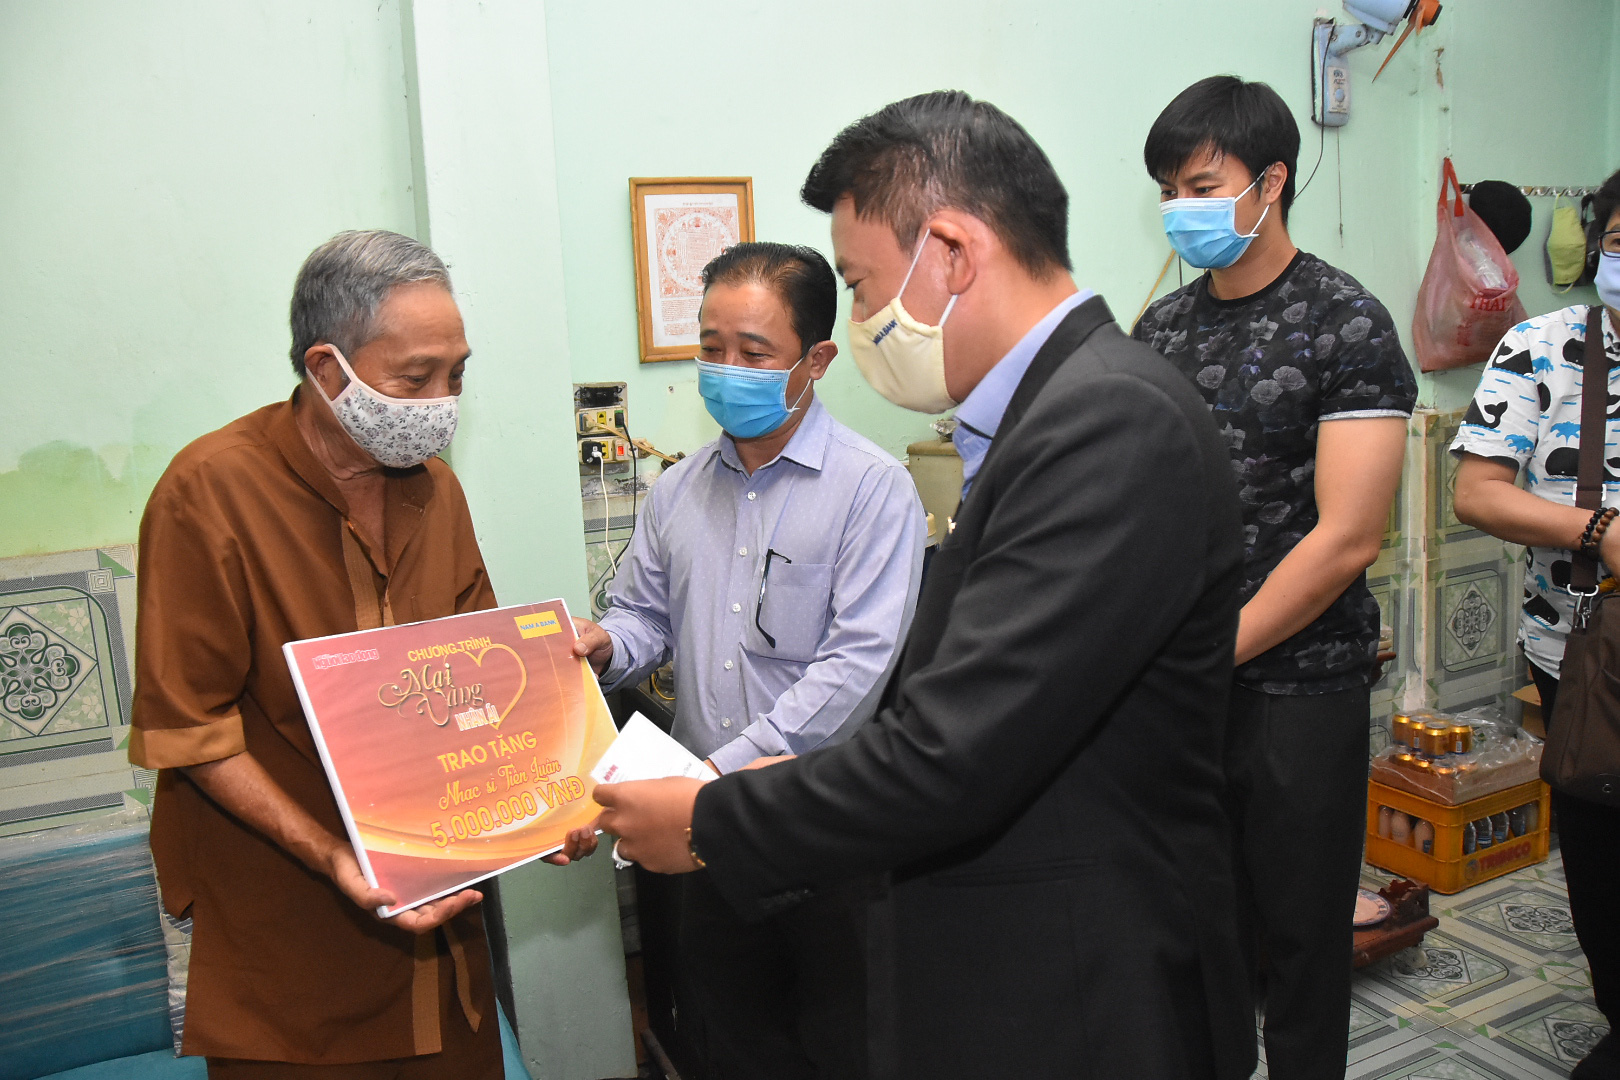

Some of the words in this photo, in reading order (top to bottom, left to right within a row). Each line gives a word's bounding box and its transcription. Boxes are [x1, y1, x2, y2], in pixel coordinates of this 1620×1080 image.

[540, 619, 557, 627] BANK
[407, 642, 458, 662] CHƯƠNG
[457, 636, 492, 652] TRÌNH
[391, 663, 454, 697] Mai
[455, 707, 488, 731] NHÂN
[437, 745, 488, 773] TRAO
[488, 731, 537, 760] TẶNG
[439, 780, 481, 810] Nhạc
[430, 791, 538, 848] 5.000.000
[536, 775, 586, 809] VNĐ
